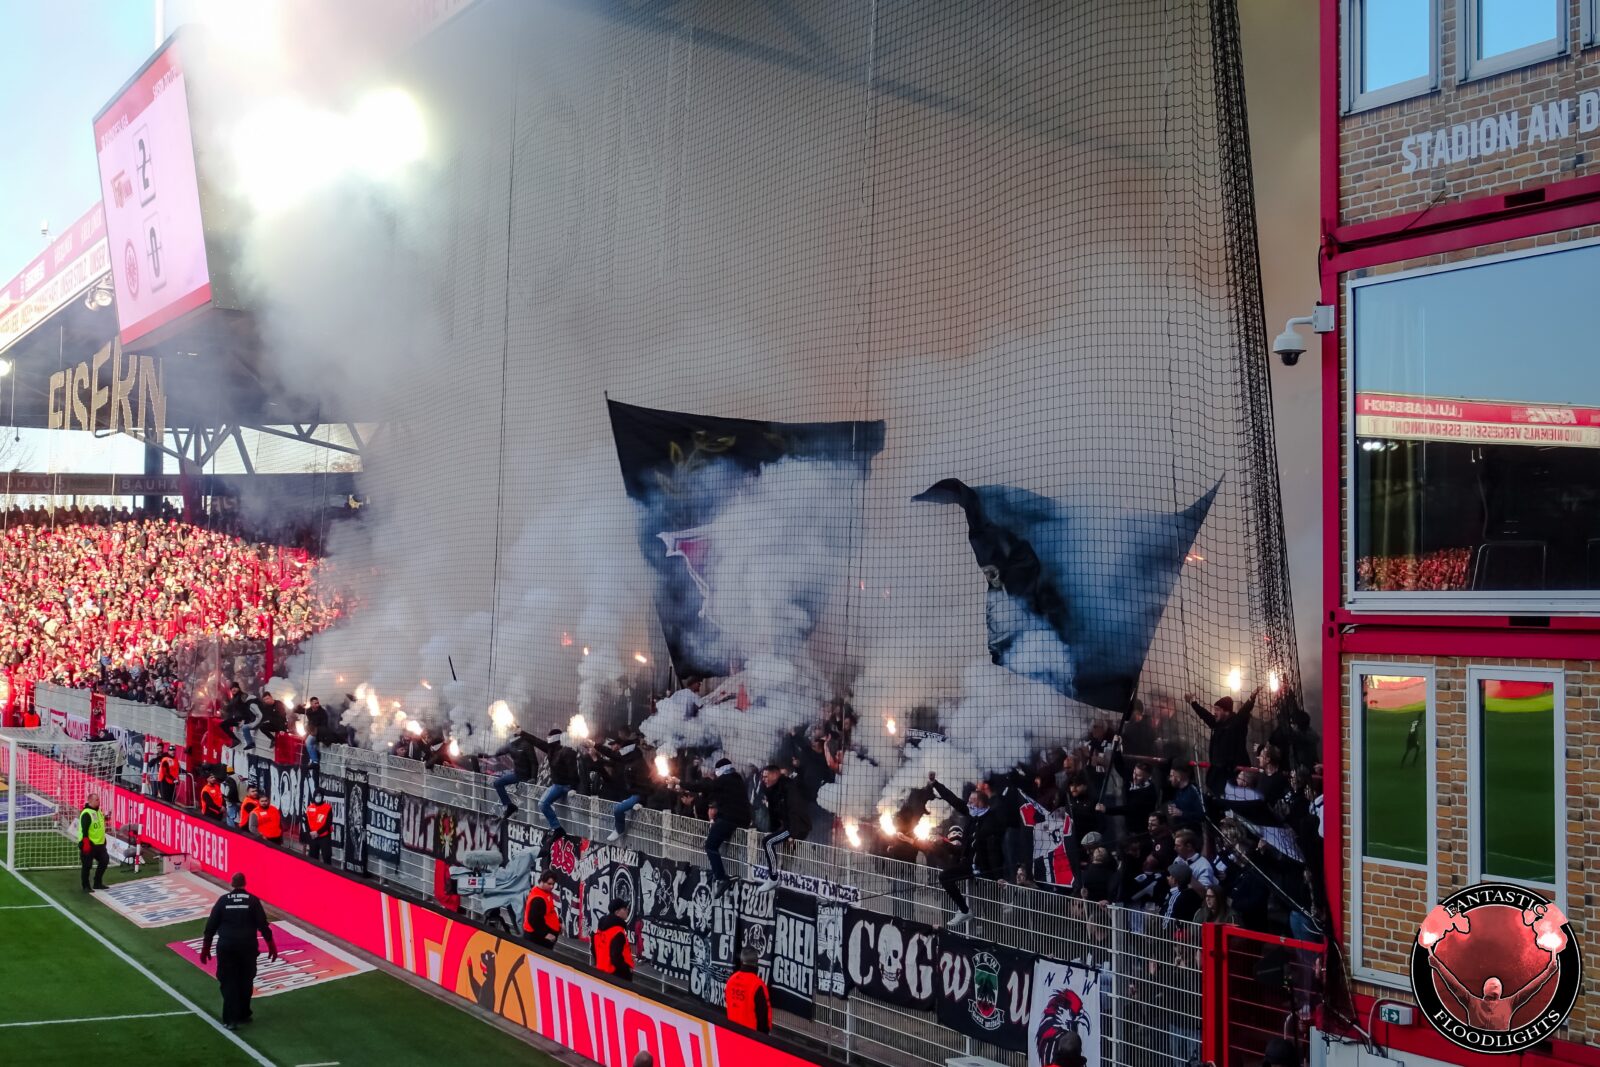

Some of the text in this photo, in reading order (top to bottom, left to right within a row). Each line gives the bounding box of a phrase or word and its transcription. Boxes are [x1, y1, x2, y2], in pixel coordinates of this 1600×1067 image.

[1402, 111, 1518, 174] STADION
[1527, 98, 1569, 146] AN
[138, 137, 151, 190] 2
[149, 226, 161, 279] 0
[116, 794, 126, 824] AN
[145, 807, 171, 845] ALTEN
[175, 814, 228, 873] FÖRSTEREI
[641, 933, 692, 971] FFM
[775, 914, 815, 967] RIED
[773, 956, 814, 996] GEBIET
